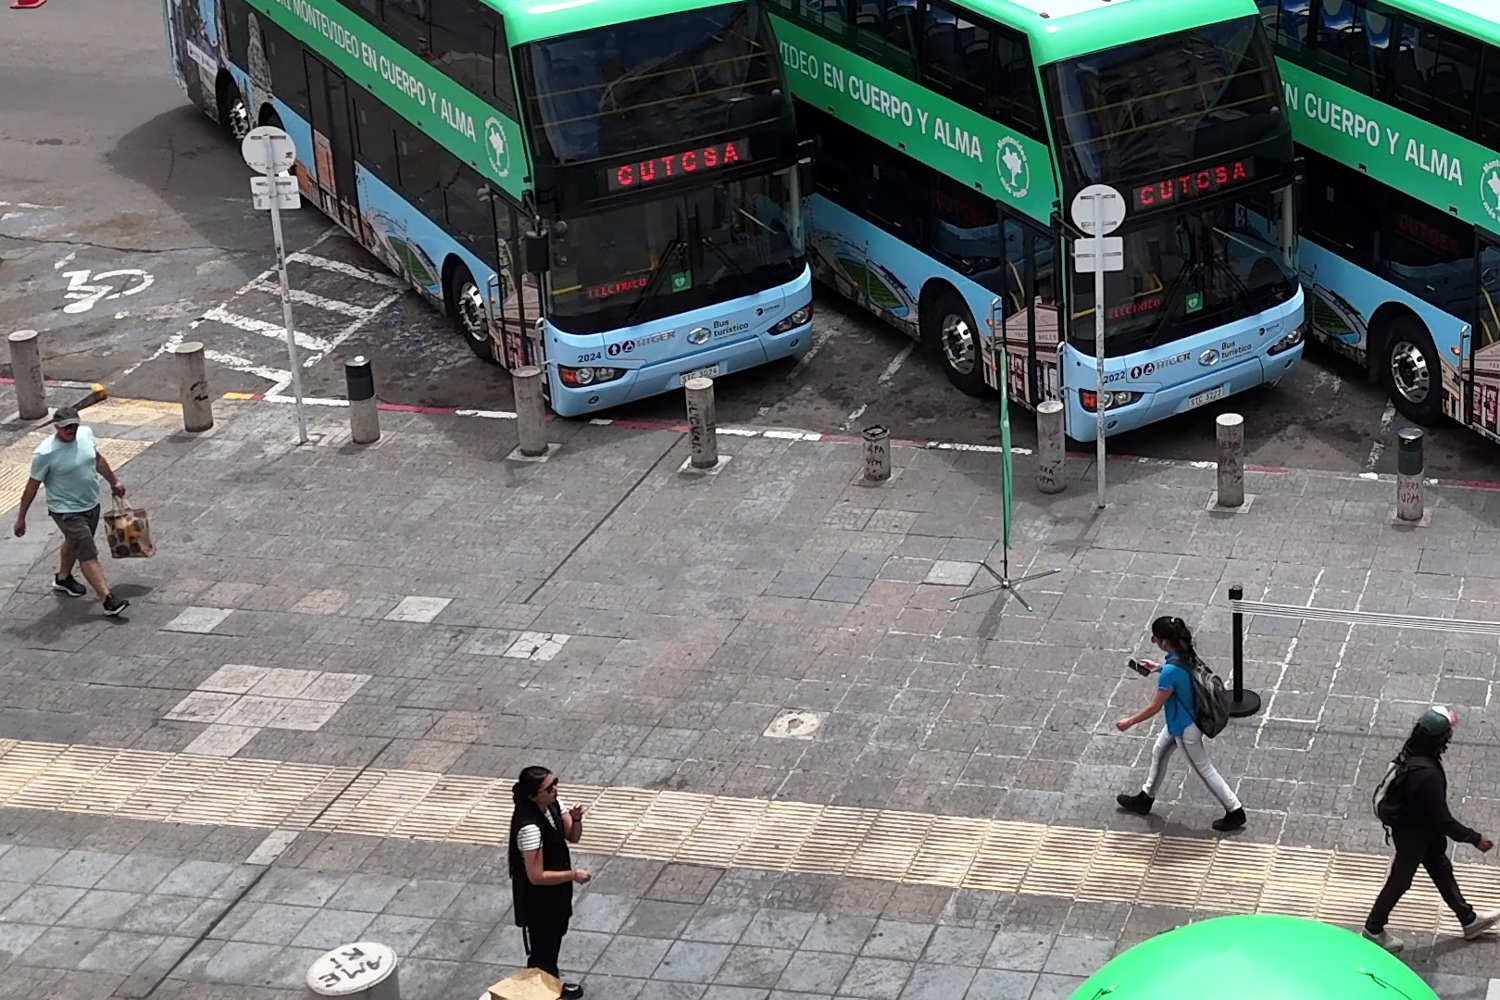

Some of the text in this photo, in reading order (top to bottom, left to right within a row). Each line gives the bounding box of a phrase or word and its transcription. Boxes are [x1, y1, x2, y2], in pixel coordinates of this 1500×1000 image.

[361, 41, 378, 73] EN
[379, 55, 426, 106] CUERPO
[427, 87, 437, 114] Y
[440, 98, 477, 143] ALMA
[823, 61, 983, 163] EN CUERPO Y ALMA
[1304, 92, 1380, 147] CUERPO
[1386, 127, 1400, 155] Y
[1404, 138, 1463, 187] ALMA
[616, 141, 740, 186] CUTCSA
[1139, 162, 1247, 206] CUTCSA
[713, 319, 730, 329] Bus
[713, 322, 749, 337] turístico
[1221, 341, 1236, 351] Bus
[1221, 343, 1252, 360] turístico
[577, 352, 602, 363] 2024
[1156, 351, 1191, 371] HIGER
[1103, 371, 1126, 384] 2022
